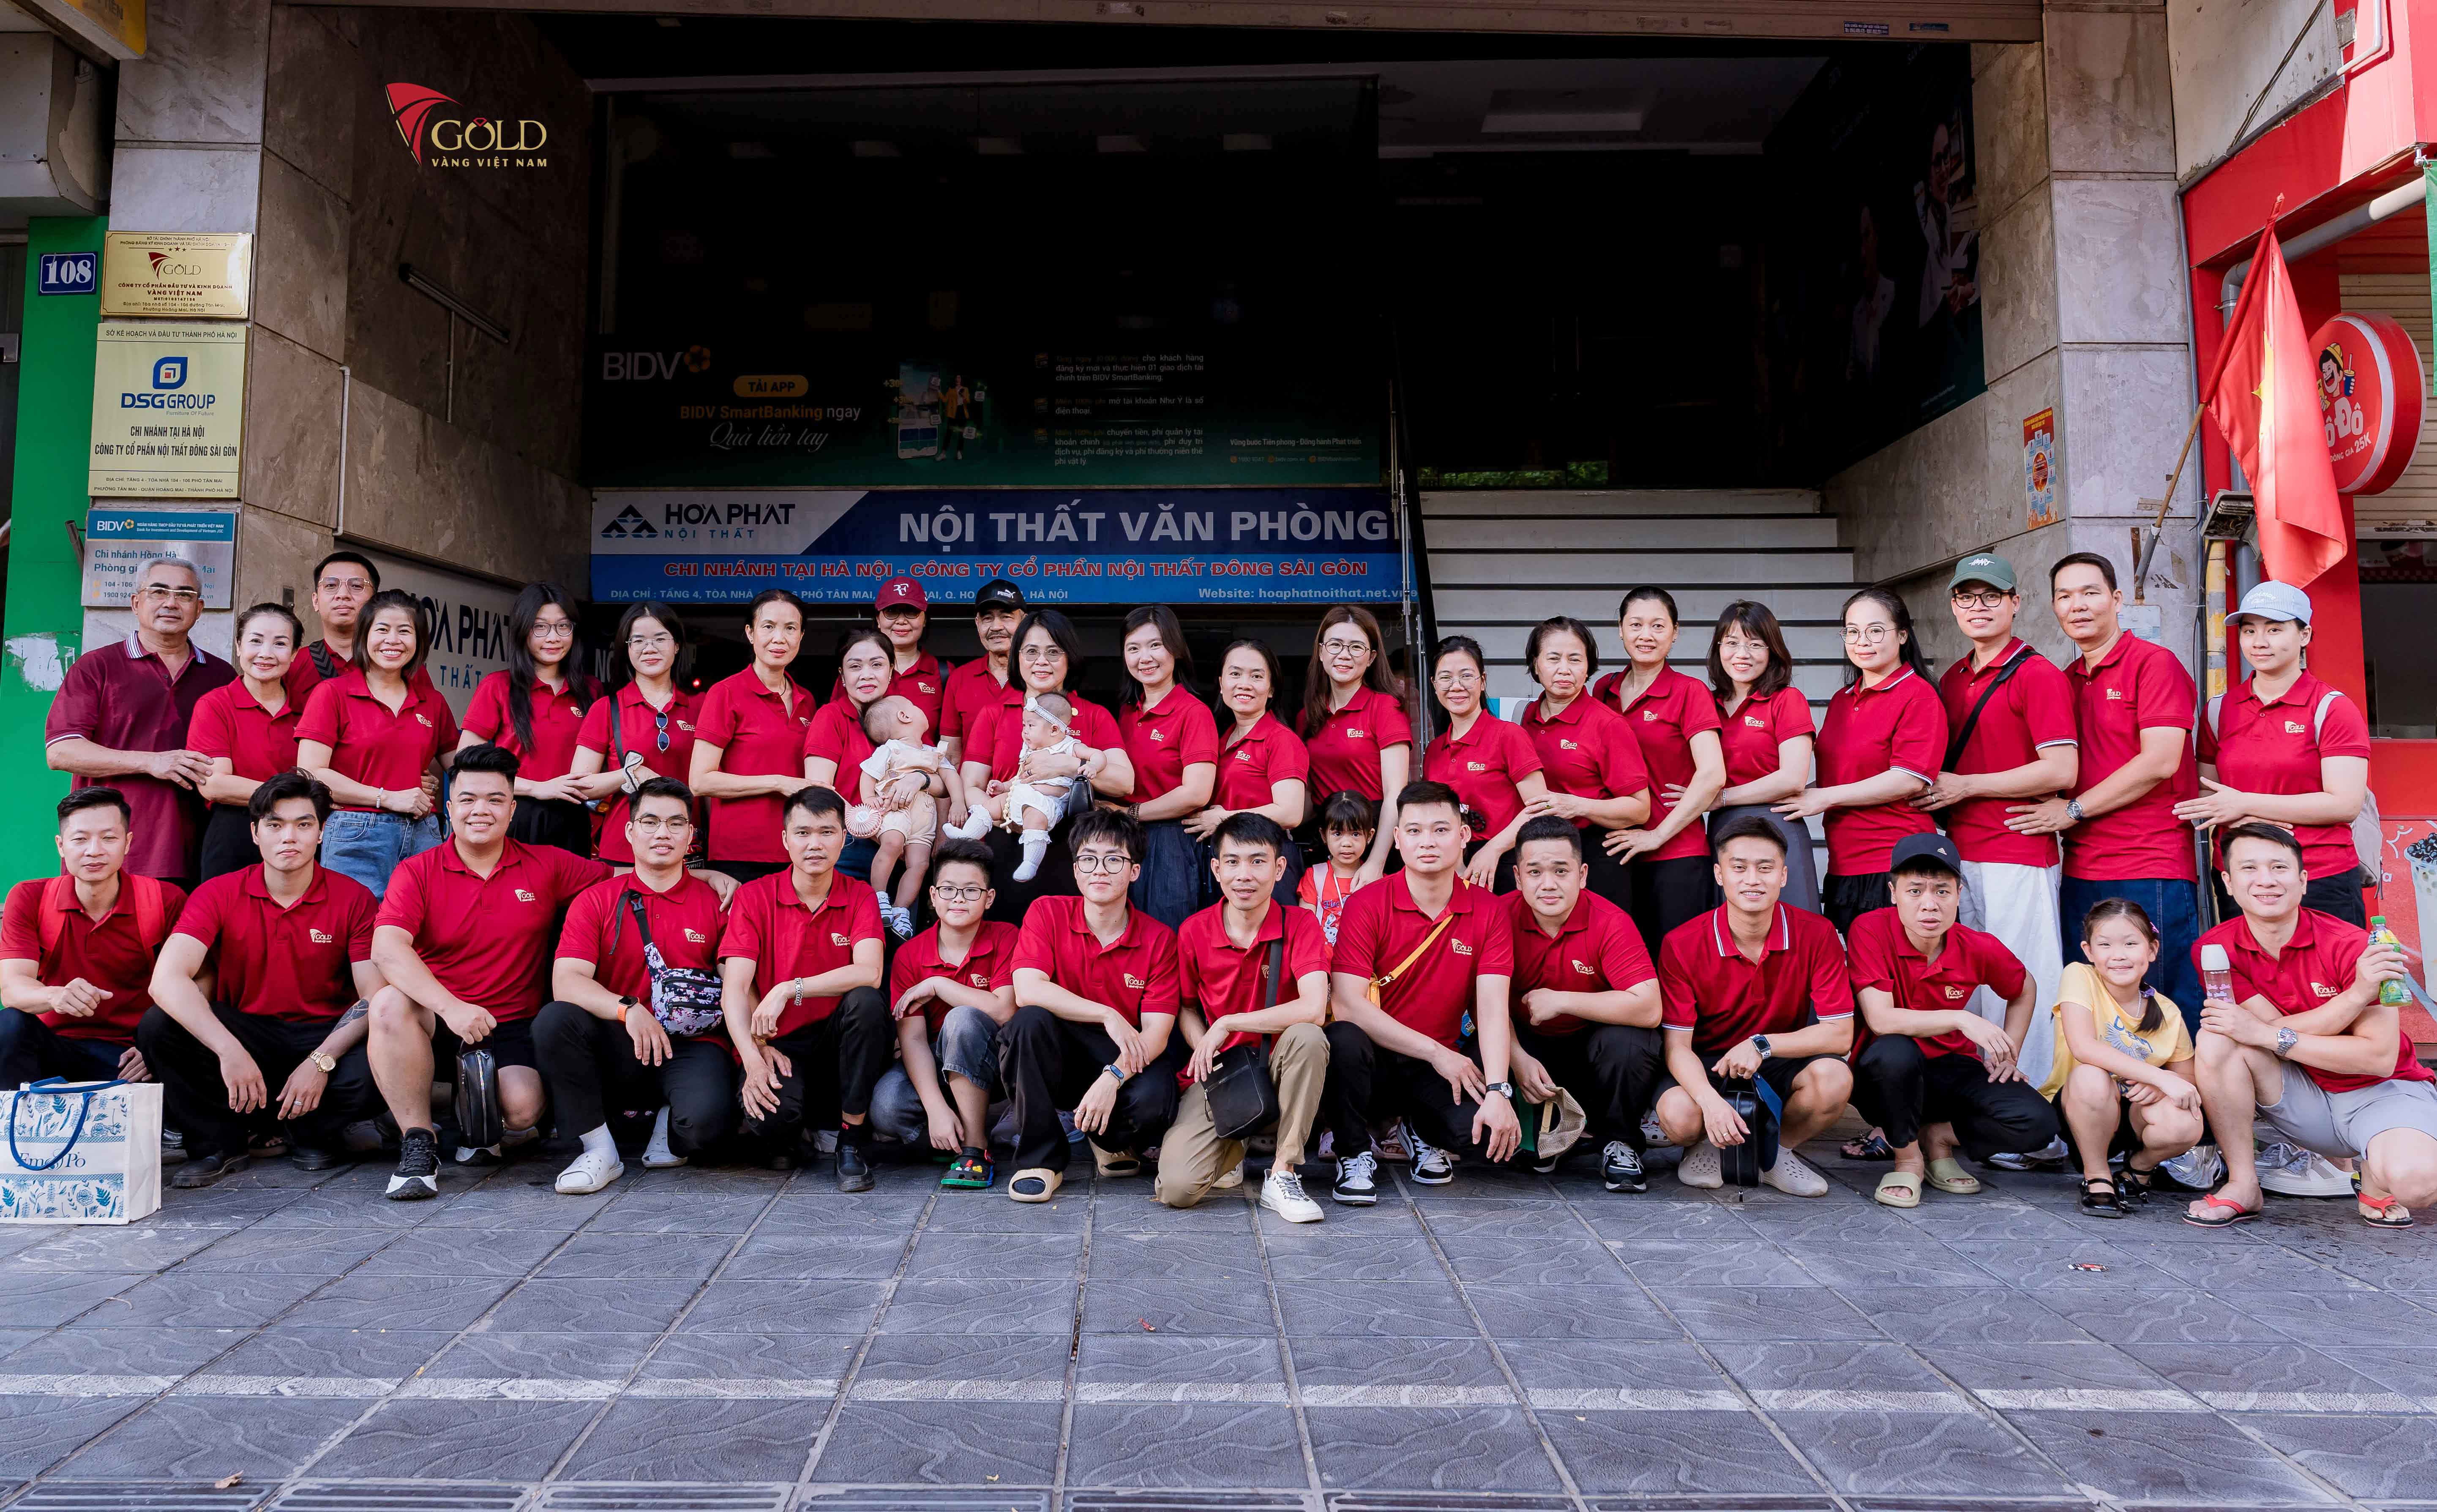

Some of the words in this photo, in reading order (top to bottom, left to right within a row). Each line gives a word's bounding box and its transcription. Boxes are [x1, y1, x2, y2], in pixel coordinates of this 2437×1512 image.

[46, 259, 91, 284] 108
[163, 264, 201, 275] GOLD
[126, 330, 147, 338] HOẠCH
[227, 331, 237, 339] NỘI
[603, 352, 684, 380] BIDV
[770, 381, 795, 393] APP
[680, 406, 715, 419] BIDV
[720, 405, 822, 421] SmartBanking
[826, 406, 861, 421] ngay
[130, 426, 142, 437] CHI
[144, 424, 167, 437] NHÁNH
[169, 426, 180, 439] TẠI
[182, 425, 191, 437] HÀ
[193, 425, 205, 440] NỘI
[710, 422, 753, 450] Quà
[757, 423, 790, 446] liền
[797, 426, 829, 453] tay
[95, 442, 114, 455] CÔNG
[116, 444, 124, 455] TY
[126, 440, 136, 456] CỔ
[136, 441, 156, 456] PHẦN
[157, 443, 169, 458] NỘI
[171, 442, 188, 456] THẤT
[189, 443, 208, 456] ĐÔNG
[210, 443, 221, 456] SÀI
[223, 443, 237, 457] GÒN
[2354, 431, 2372, 453] 25K
[727, 503, 796, 525] PHÁT
[96, 520, 126, 531] BIDV
[900, 505, 974, 552] NỘI
[989, 499, 1105, 542] THẤT
[1119, 503, 1214, 541] VĂN
[1231, 503, 1388, 541] PHÒNG
[665, 528, 696, 541] NỘI
[710, 527, 754, 538] THẤT
[95, 550, 109, 558] Chi
[111, 550, 137, 559] nhánh
[94, 563, 126, 574] Phòng
[664, 562, 699, 577] CHI
[703, 559, 777, 577] NHÁNH
[782, 562, 815, 581] TẠI
[821, 559, 851, 577] HÀ
[856, 560, 892, 581] NỘI
[910, 560, 970, 577] CÔNG
[975, 563, 1004, 577] TY
[1007, 555, 1038, 577] CỔ
[1043, 557, 1102, 577] PHẦN
[1107, 559, 1145, 580] NỘI
[1149, 557, 1206, 576] THẤT
[1210, 559, 1273, 576] ĐÔNG
[1278, 559, 1315, 576] SÀI
[1320, 558, 1367, 576] GÒN
[633, 587, 650, 598] CHỈ
[660, 587, 690, 599] TẦNG
[705, 588, 727, 599] TÒA
[730, 588, 753, 599] NHÀ
[801, 587, 824, 599] PHỐ
[827, 590, 849, 599] TÂN
[852, 591, 876, 600] MAI,
[944, 591, 956, 599] Q.
[1030, 588, 1046, 599] HÀ
[1048, 588, 1068, 601] NỘI
[1198, 588, 1255, 598] Website:
[458, 604, 510, 662] PHÁ
[1456, 944, 1472, 952] GOLD
[2318, 986, 2337, 994] GOLD
